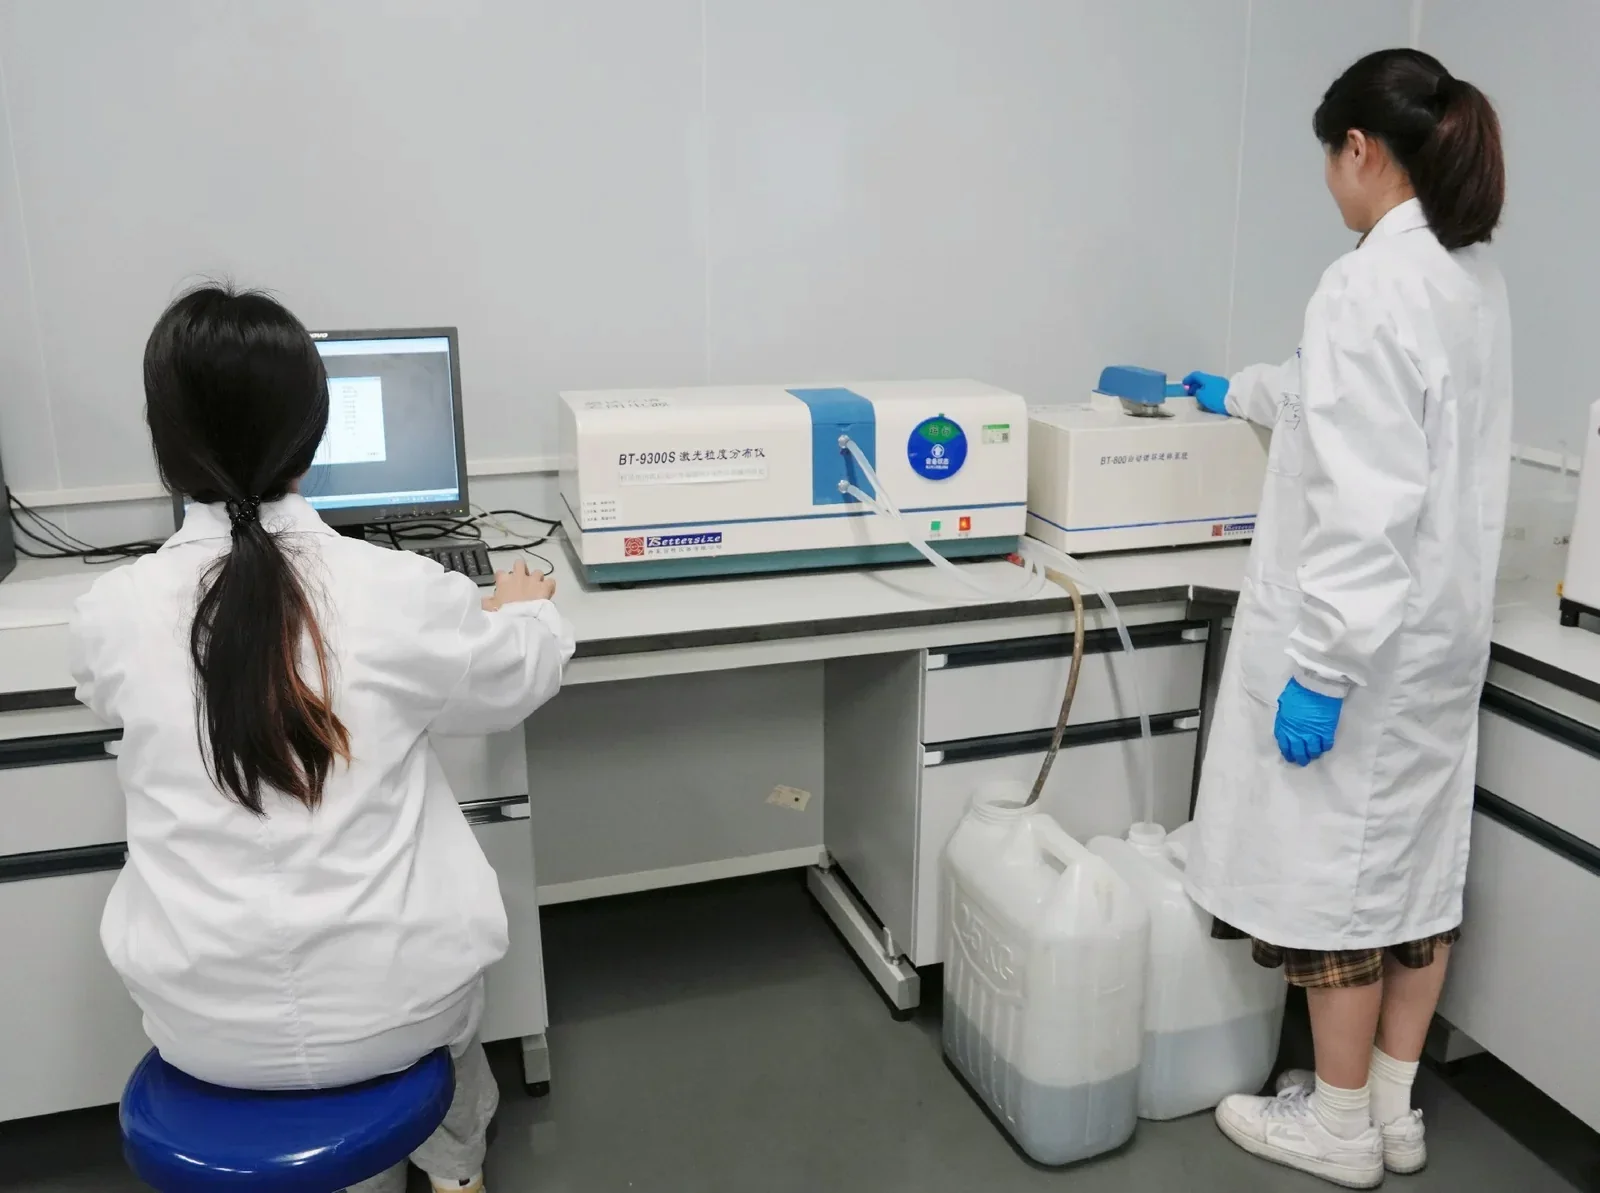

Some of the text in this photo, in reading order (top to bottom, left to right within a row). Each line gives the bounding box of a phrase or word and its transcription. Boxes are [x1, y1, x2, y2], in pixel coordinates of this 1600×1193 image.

[618, 447, 766, 465] BT-9300S 激光粒度分布仪
[647, 534, 721, 547] Bettersize
